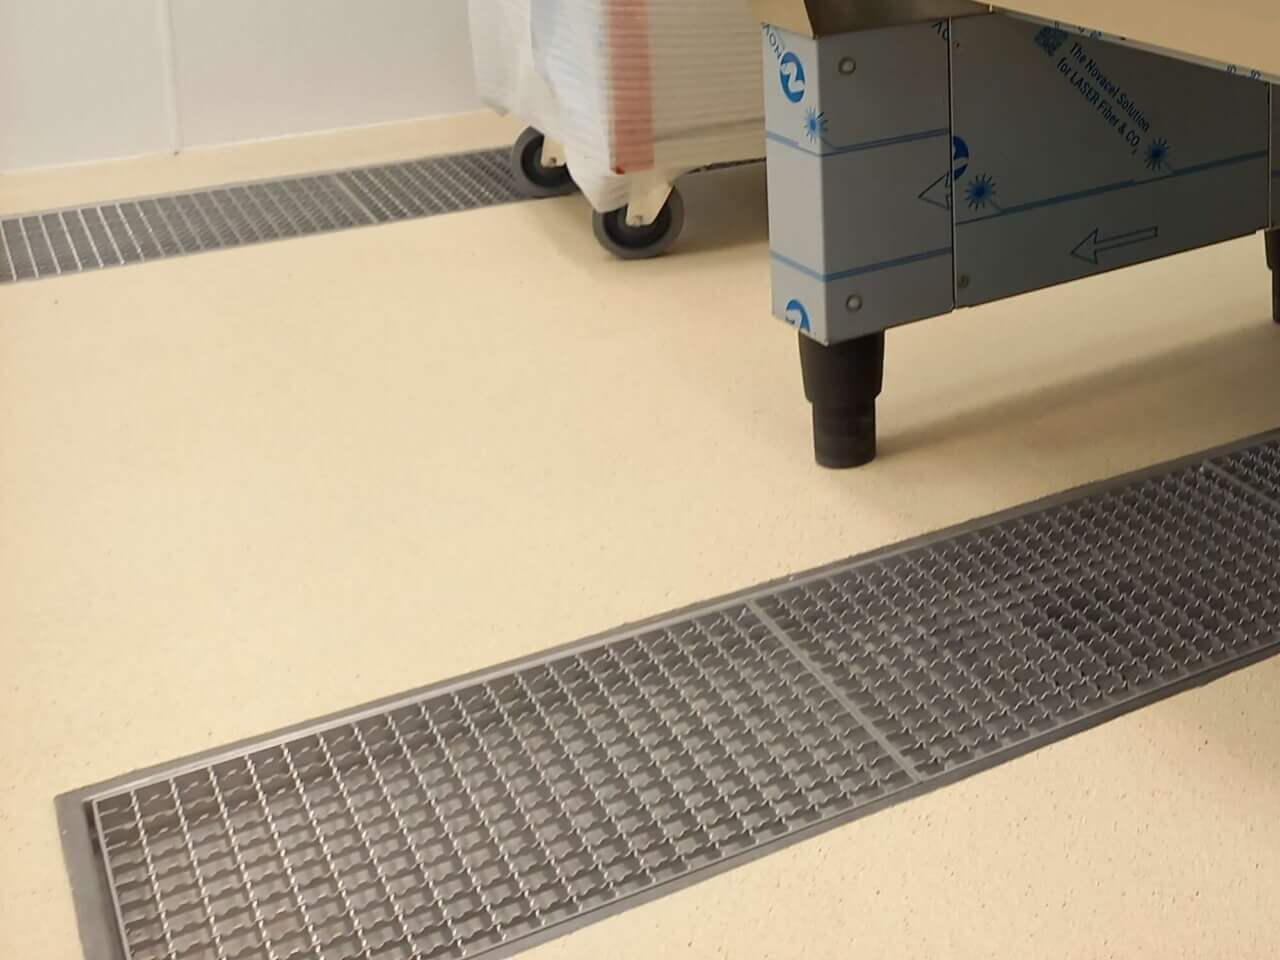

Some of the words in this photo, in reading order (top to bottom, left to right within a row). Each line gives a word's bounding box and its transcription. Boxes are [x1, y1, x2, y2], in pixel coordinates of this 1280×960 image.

[1056, 56, 1072, 77] for
[1070, 70, 1100, 105] LASER
[1097, 99, 1121, 127] Fiber
[1118, 121, 1128, 136] &
[1069, 41, 1087, 64] The
[1084, 58, 1121, 99] Novacel
[1116, 92, 1151, 133] Solution
